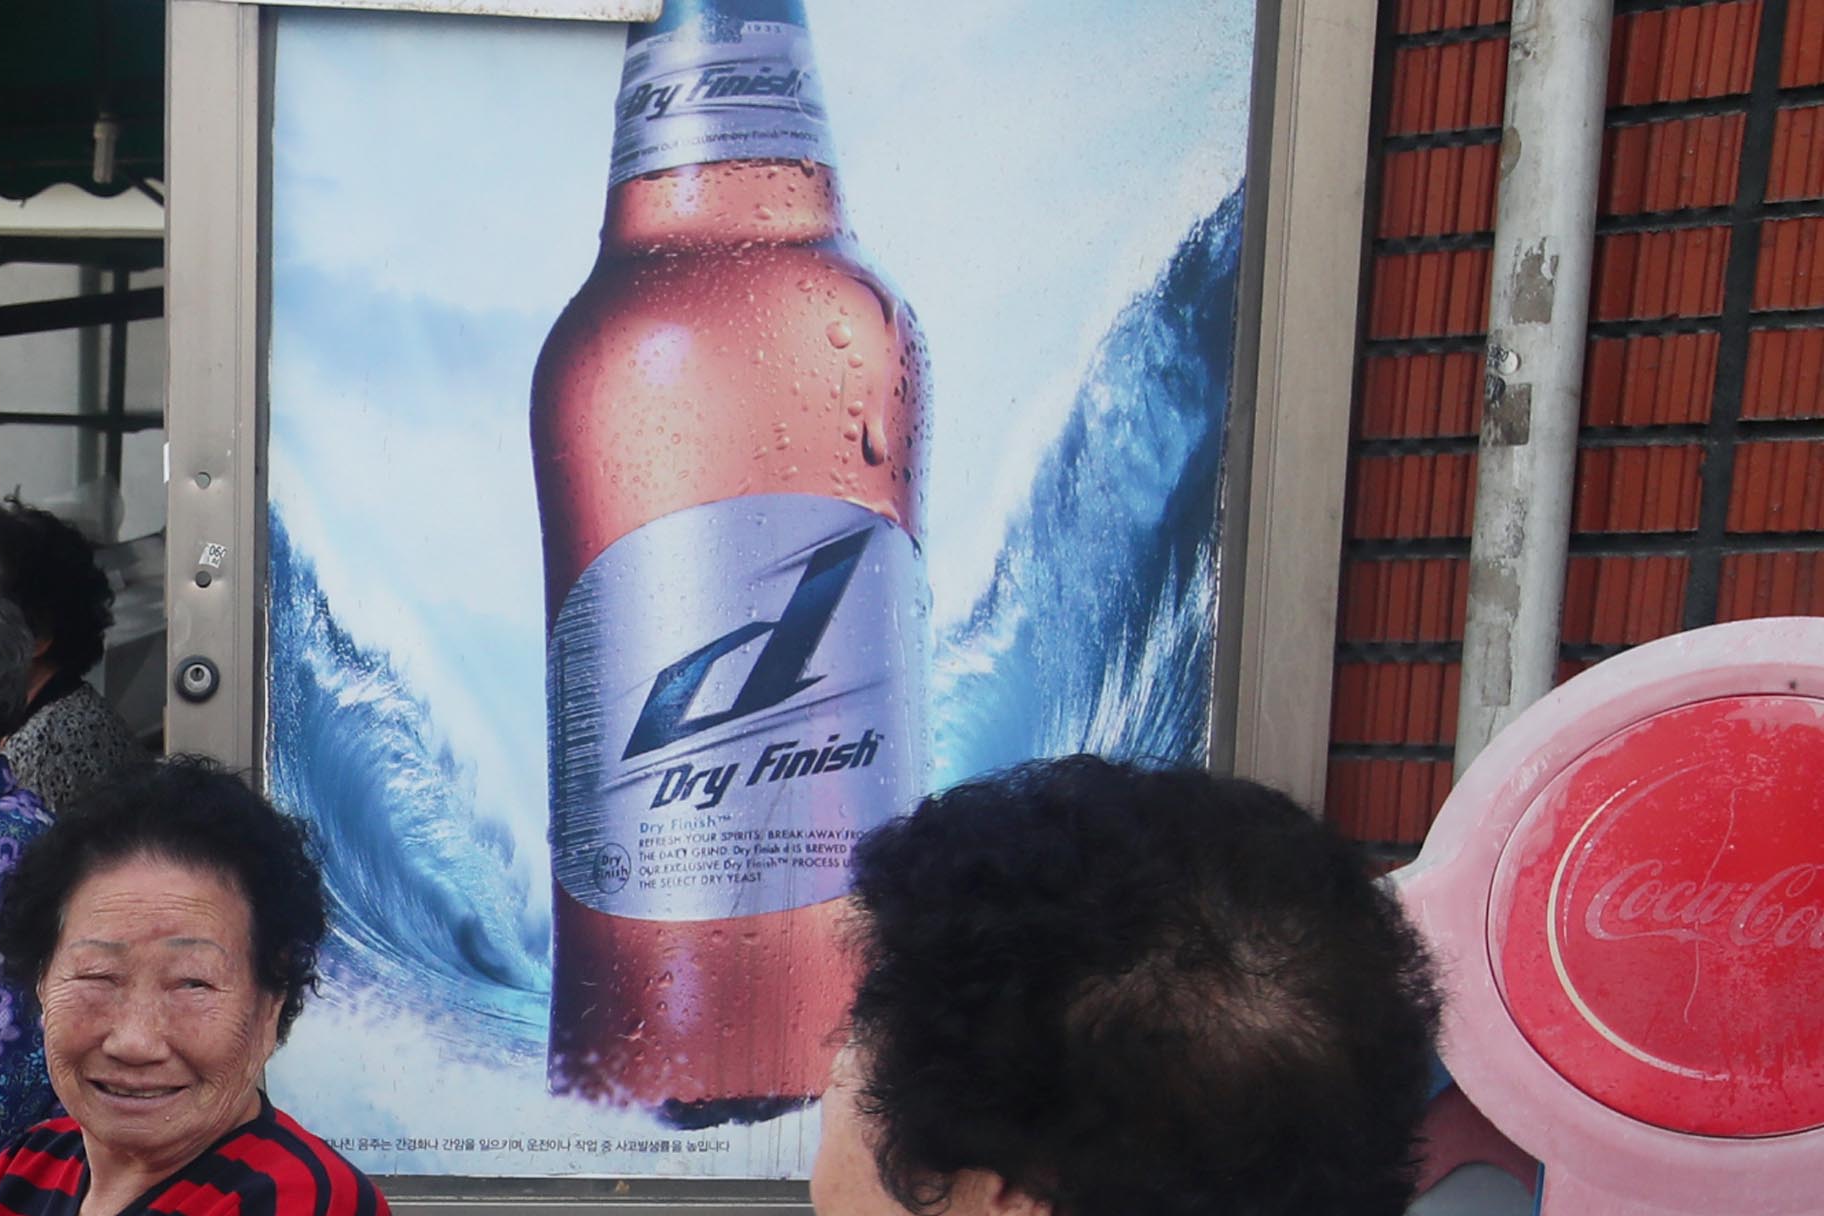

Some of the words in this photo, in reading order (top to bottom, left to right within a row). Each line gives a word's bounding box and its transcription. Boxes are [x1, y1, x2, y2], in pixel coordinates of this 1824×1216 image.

[625, 82, 682, 122] Dry
[650, 761, 739, 810] Dry
[639, 822, 664, 834] Dry
[686, 832, 718, 845] YOUR
[768, 828, 804, 840] BREAK
[808, 828, 842, 840] AWAY
[639, 851, 656, 861] THE
[732, 844, 752, 857] Dry
[792, 844, 803, 854] IS
[806, 843, 848, 854] BREWED
[663, 859, 721, 874] EXCLUSIVE
[724, 858, 743, 872] Dry
[792, 858, 840, 869] PROCESS
[639, 879, 657, 890] THE
[700, 874, 723, 886] DRY
[358, 1138, 392, 1151] 음주는
[395, 1138, 439, 1151] 간경화나
[442, 1138, 475, 1151] 간암을
[526, 1138, 571, 1151] 운전이나
[575, 1140, 597, 1152] 작업
[601, 1139, 612, 1152] 중
[685, 1140, 730, 1152] 높입니다
